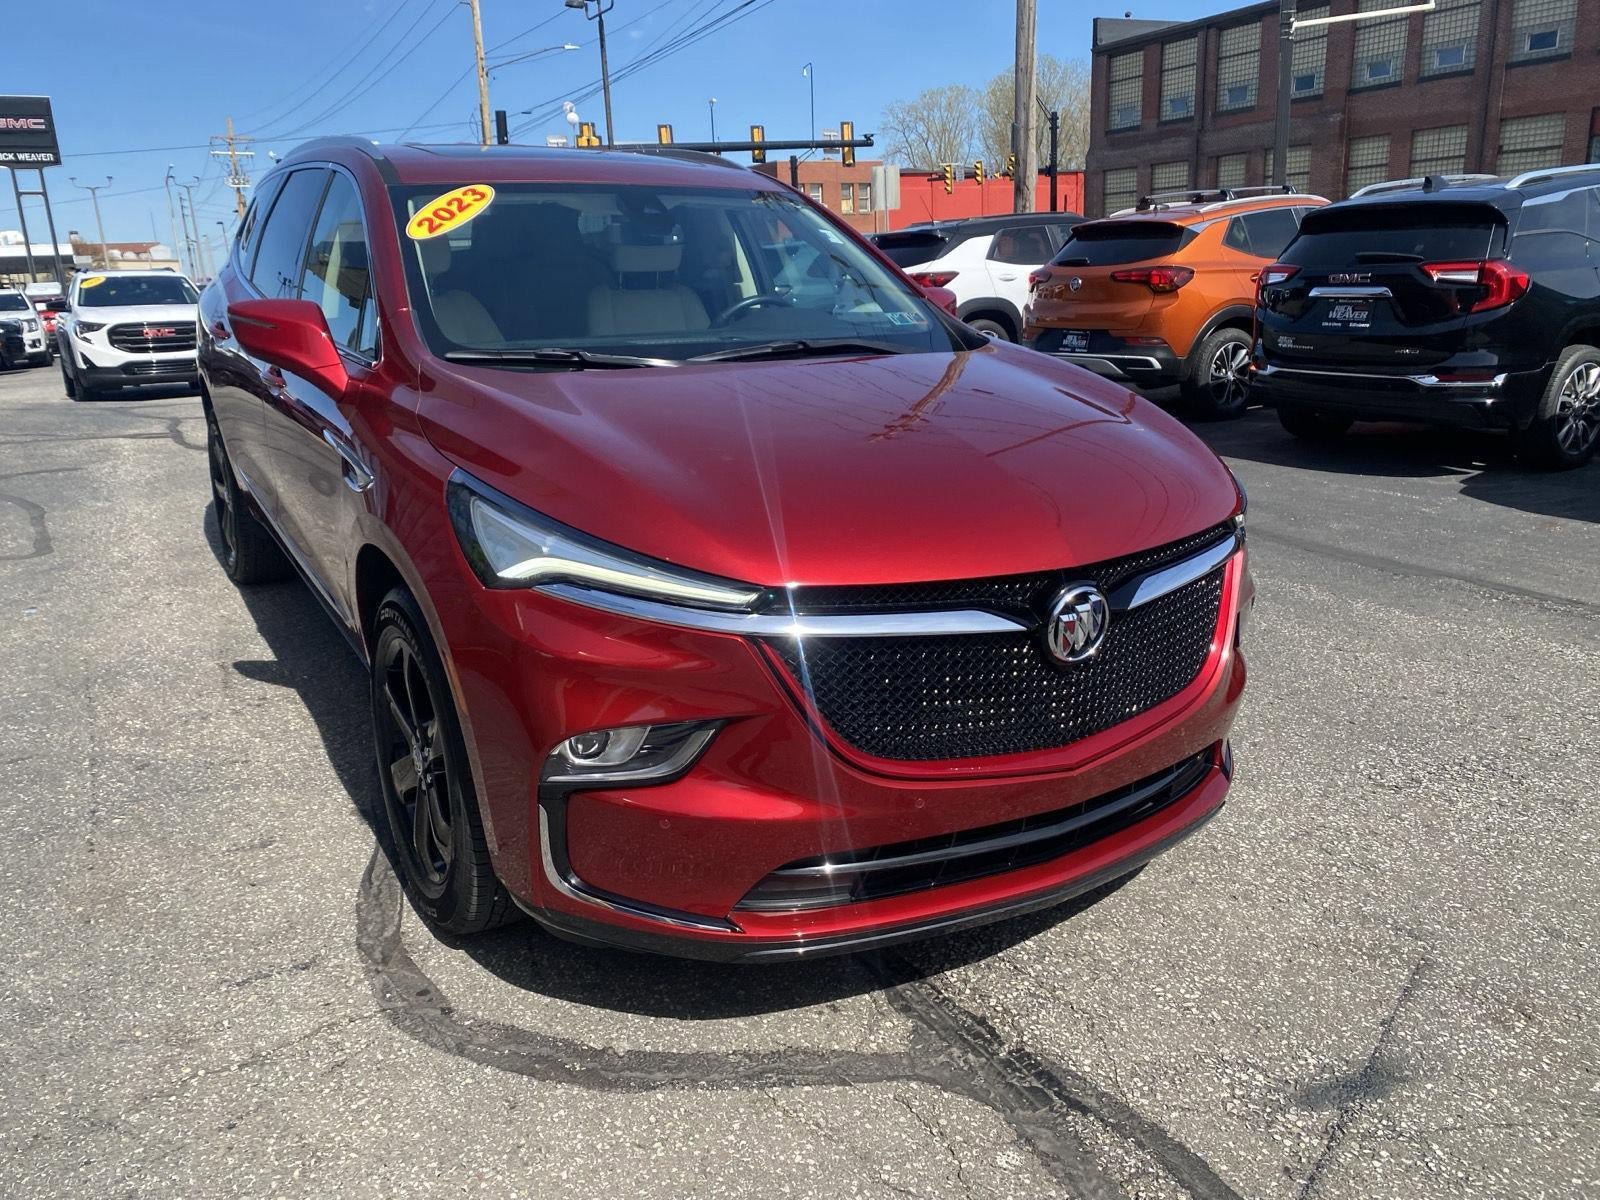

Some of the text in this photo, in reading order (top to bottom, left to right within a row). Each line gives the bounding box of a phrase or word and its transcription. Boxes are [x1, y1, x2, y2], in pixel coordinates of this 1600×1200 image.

[0, 152, 54, 161] ICK WEAVER
[416, 188, 486, 234] 2023
[1328, 272, 1372, 284] GMC
